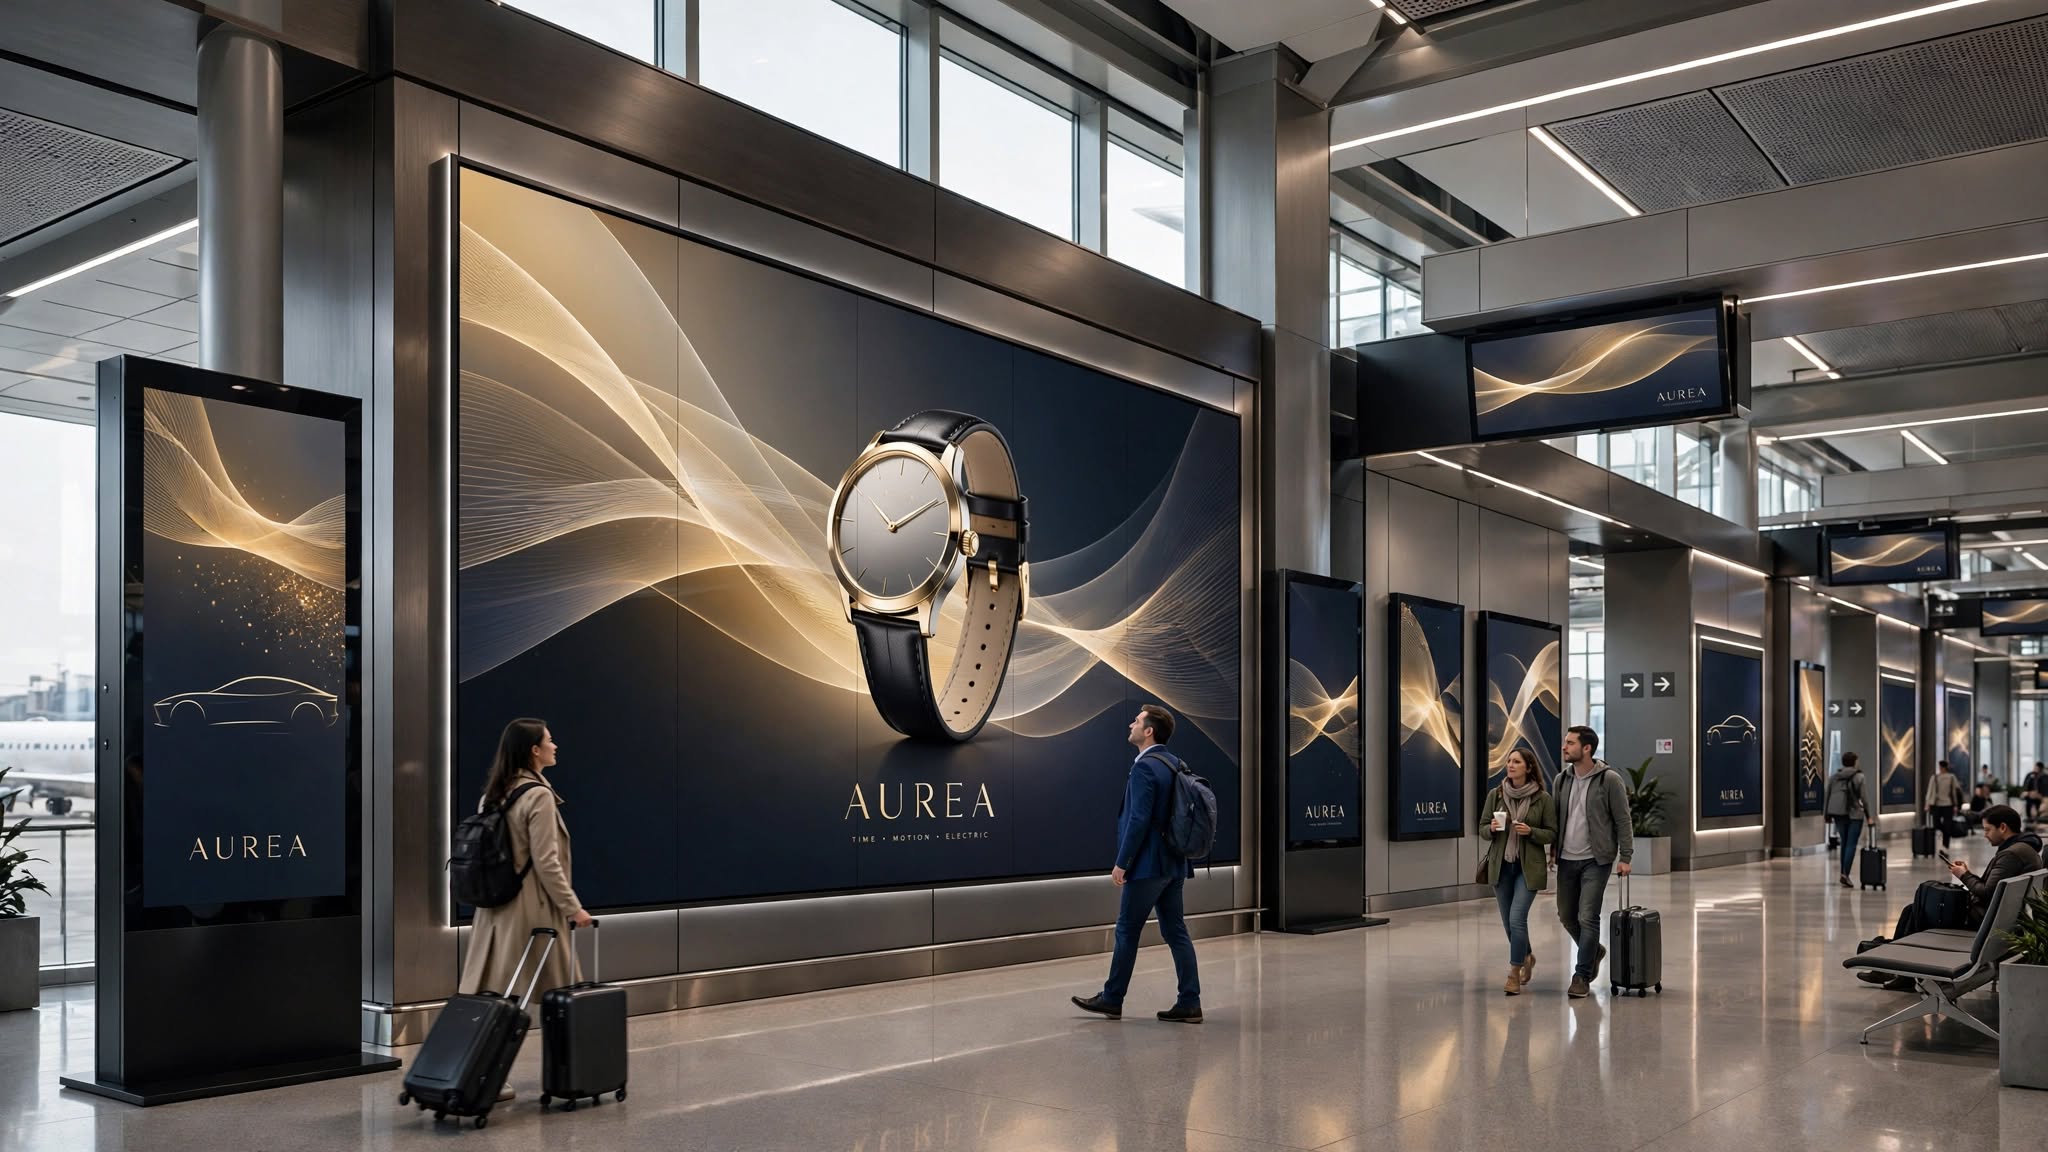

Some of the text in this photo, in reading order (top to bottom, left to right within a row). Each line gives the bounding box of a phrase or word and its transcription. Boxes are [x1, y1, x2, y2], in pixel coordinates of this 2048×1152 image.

[1657, 387, 1706, 402] AUREA
[844, 782, 995, 820] AUREA
[1720, 789, 1744, 800] AUREA
[1305, 804, 1345, 818] AUREA
[1414, 801, 1448, 815] AUREA
[852, 835, 876, 843] TIME
[945, 831, 989, 840] ELECTRIC
[189, 834, 307, 861] AUREA
